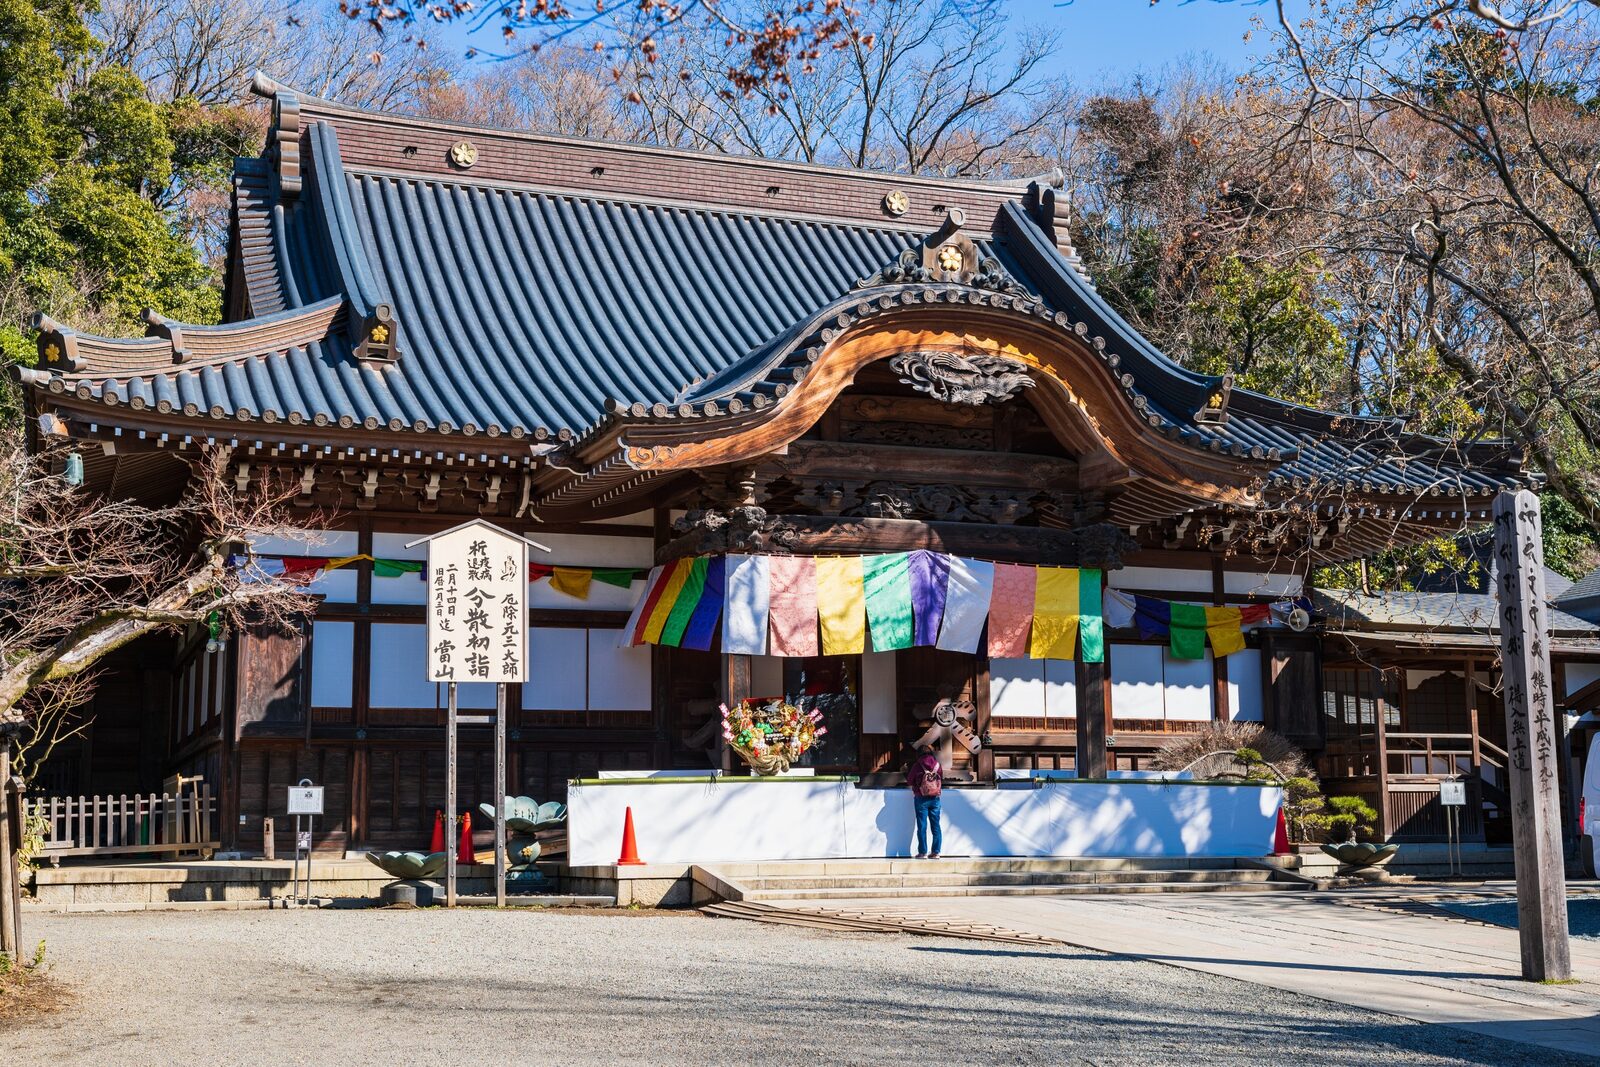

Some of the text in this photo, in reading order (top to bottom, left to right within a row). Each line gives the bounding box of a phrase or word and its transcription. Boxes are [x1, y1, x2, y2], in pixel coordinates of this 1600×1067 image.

[446, 564, 458, 616] 二月十四日
[463, 586, 496, 679] 分散初詣
[501, 593, 519, 680] 厄除元三大師
